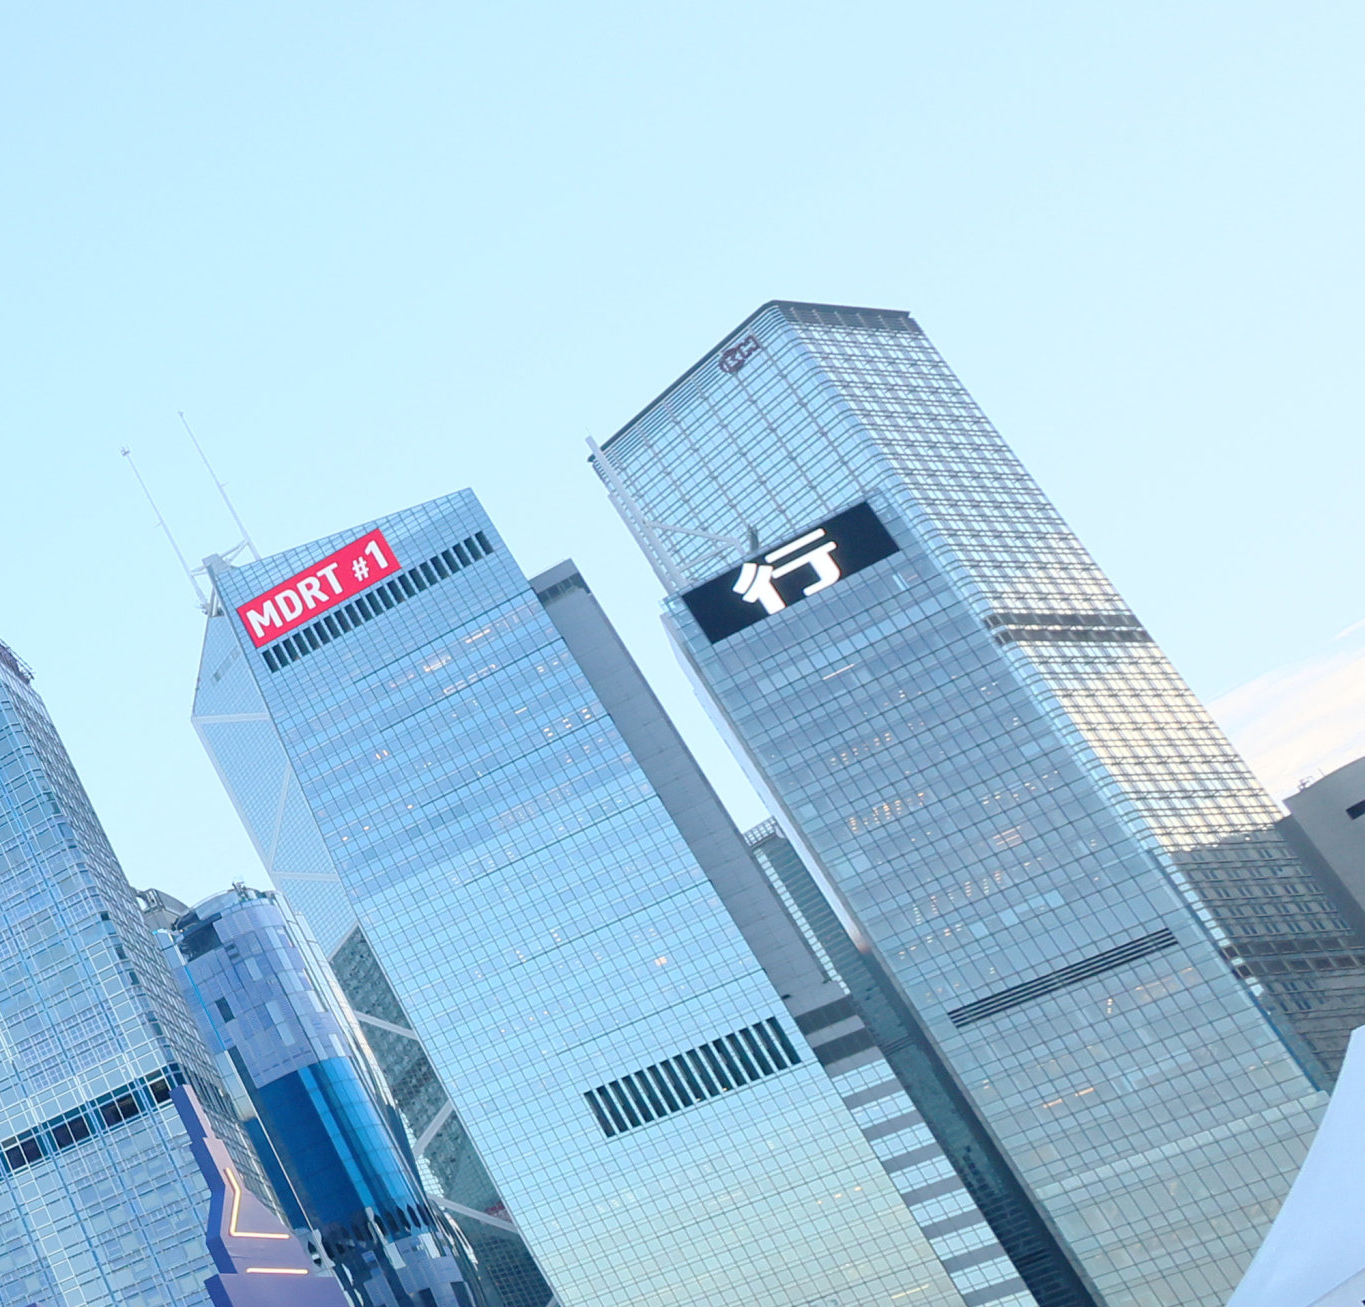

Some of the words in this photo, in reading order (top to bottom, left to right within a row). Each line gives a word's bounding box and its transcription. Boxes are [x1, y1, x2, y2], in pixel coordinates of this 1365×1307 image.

[246, 562, 343, 638] MDRT
[352, 540, 388, 582] #1
[732, 528, 841, 615] 行
